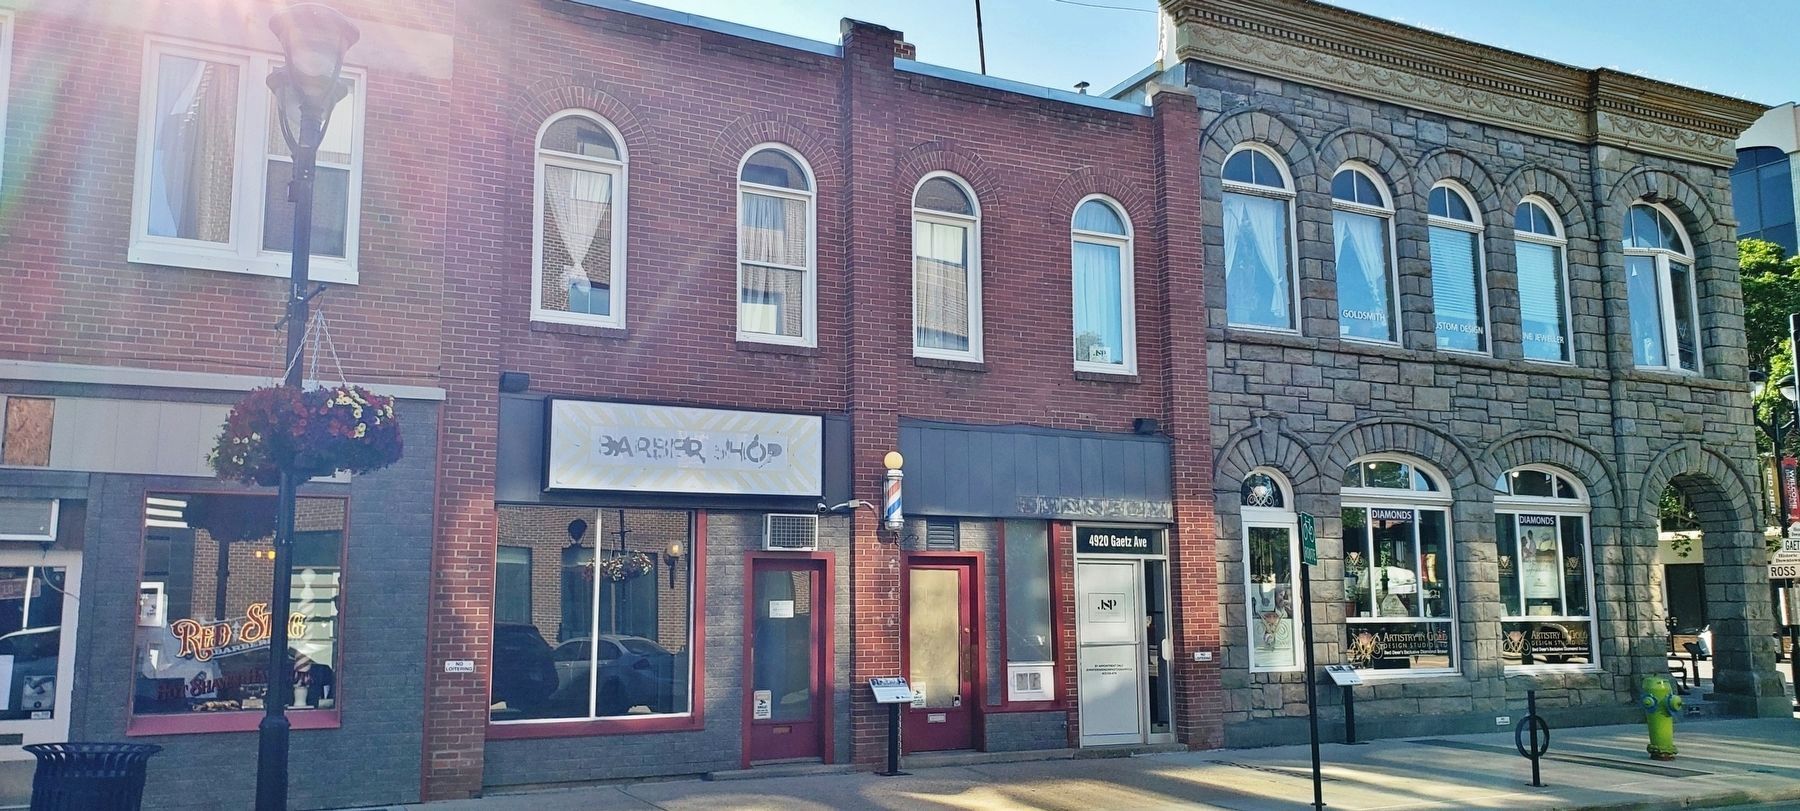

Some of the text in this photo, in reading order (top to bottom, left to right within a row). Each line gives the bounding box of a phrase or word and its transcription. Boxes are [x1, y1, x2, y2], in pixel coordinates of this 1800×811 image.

[1342, 310, 1386, 321] GOLDSMITH
[1459, 324, 1484, 334] DESIGN
[1789, 470, 1798, 509] WELCOME
[1769, 489, 1777, 515] DEER
[1372, 510, 1412, 519] DIAMONDS
[1520, 516, 1555, 525] DIAMONDS
[1089, 534, 1147, 547] 4920 Gaetz Ave
[1770, 566, 1796, 577] ROSS
[1097, 600, 1117, 610] JSP
[171, 603, 307, 661] RED STG
[1384, 632, 1416, 641] ARTISTRY
[1427, 631, 1448, 640] GOLD
[1531, 630, 1560, 639] ARTISTRY
